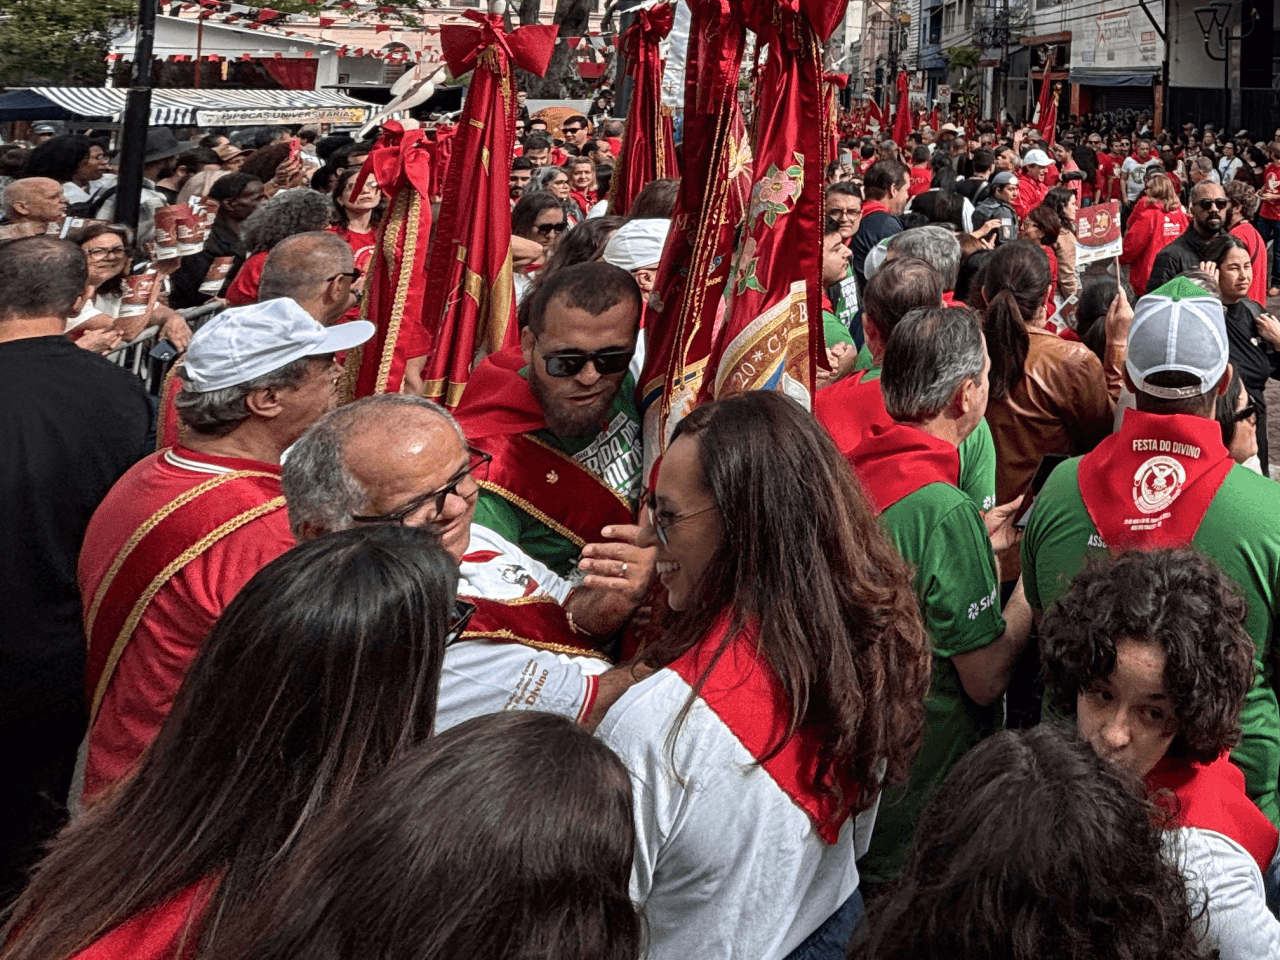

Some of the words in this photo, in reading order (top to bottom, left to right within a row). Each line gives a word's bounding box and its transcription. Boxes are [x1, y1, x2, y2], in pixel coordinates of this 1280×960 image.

[221, 111, 270, 120] PIPOCAS
[1132, 439, 1158, 452] FESTA
[1159, 440, 1171, 452] DO
[1172, 442, 1201, 459] DIVINO
[525, 669, 549, 706] Divino
